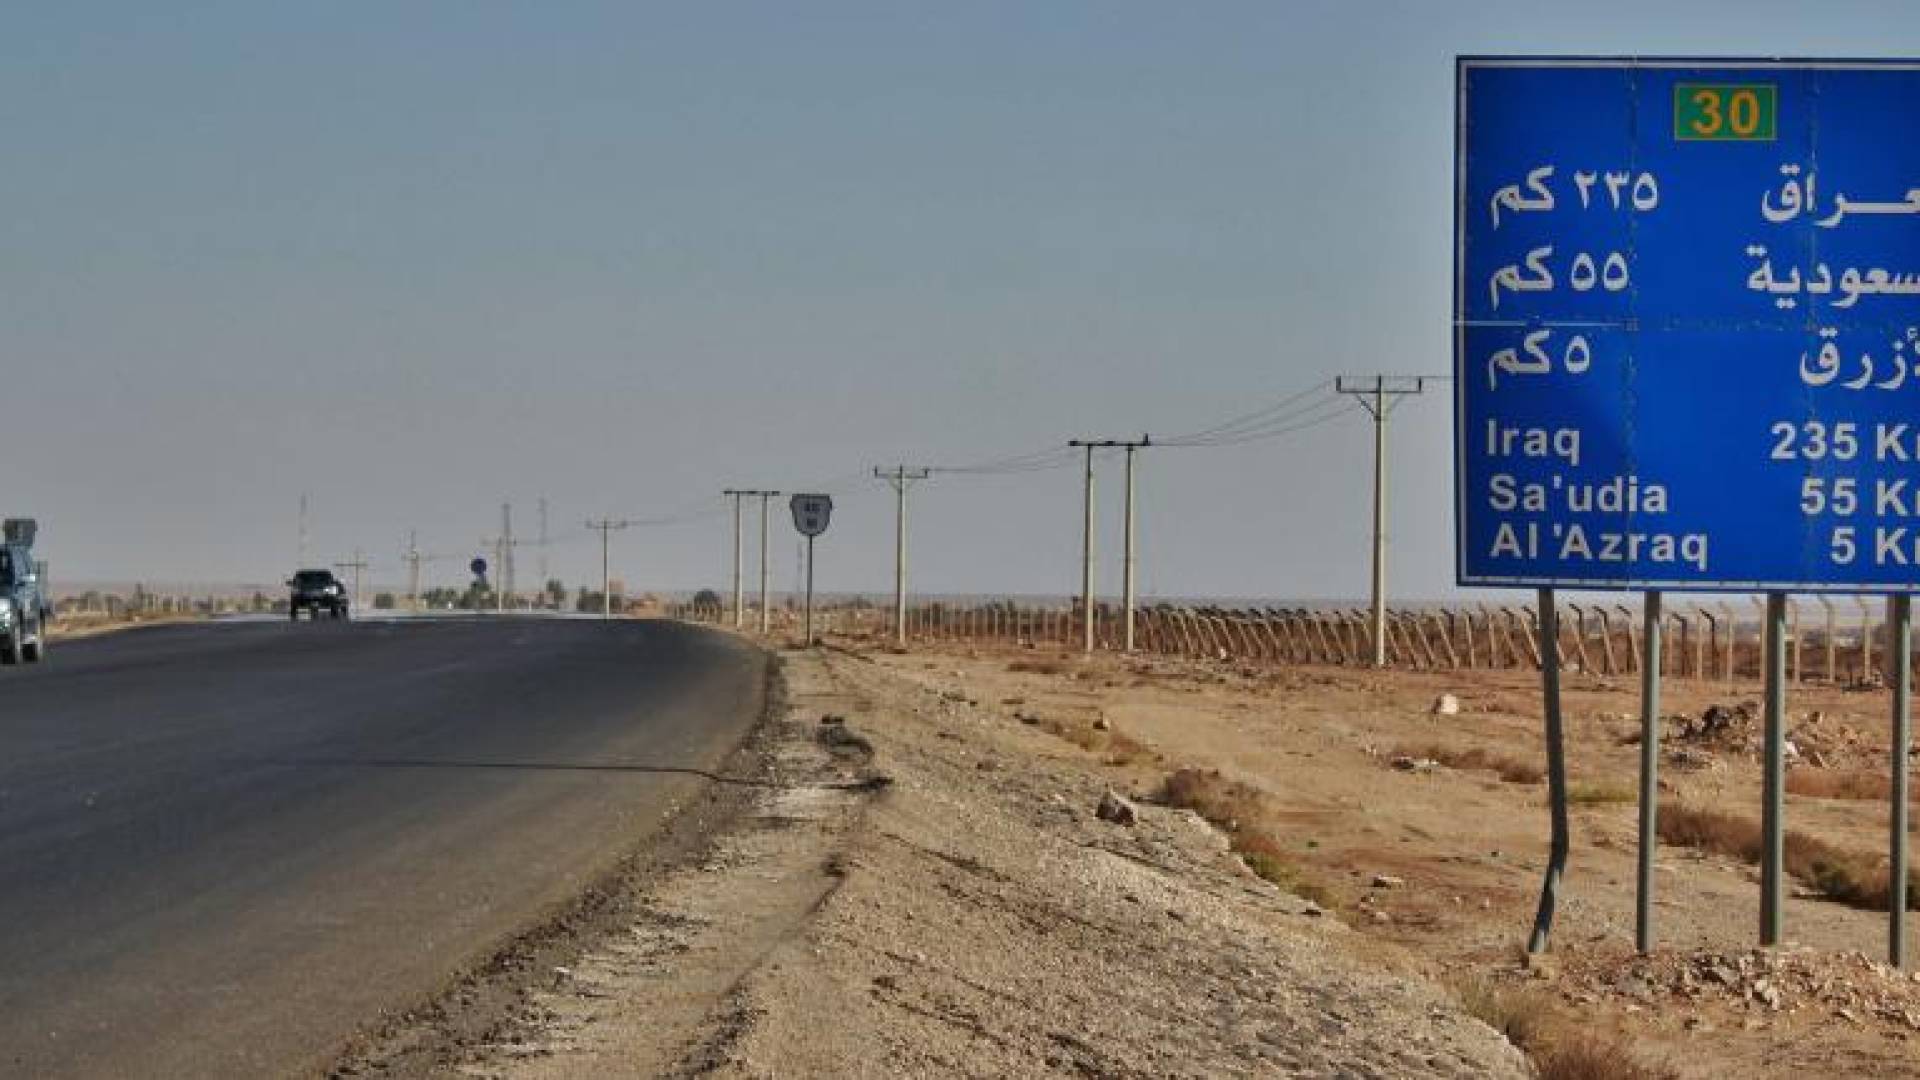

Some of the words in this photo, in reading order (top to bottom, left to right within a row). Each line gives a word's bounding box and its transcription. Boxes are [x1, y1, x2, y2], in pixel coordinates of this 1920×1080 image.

[1694, 90, 1760, 137] 30
[1490, 166, 1555, 229] كم
[1573, 171, 1659, 211] ٢٣٥
[1490, 246, 1553, 309] كم
[1570, 251, 1629, 291] ٥٥
[1487, 329, 1550, 390] كم
[1564, 334, 1591, 374] ٥
[1487, 419, 1581, 465] Iraq
[1770, 419, 1859, 460] 235
[1875, 424, 1920, 460] K
[1490, 474, 1667, 512] Sa'udia
[1800, 477, 1858, 515] 55
[1875, 479, 1920, 517] K
[1490, 522, 1538, 557] Al
[1830, 526, 1857, 563] 5
[1875, 527, 1920, 565] K
